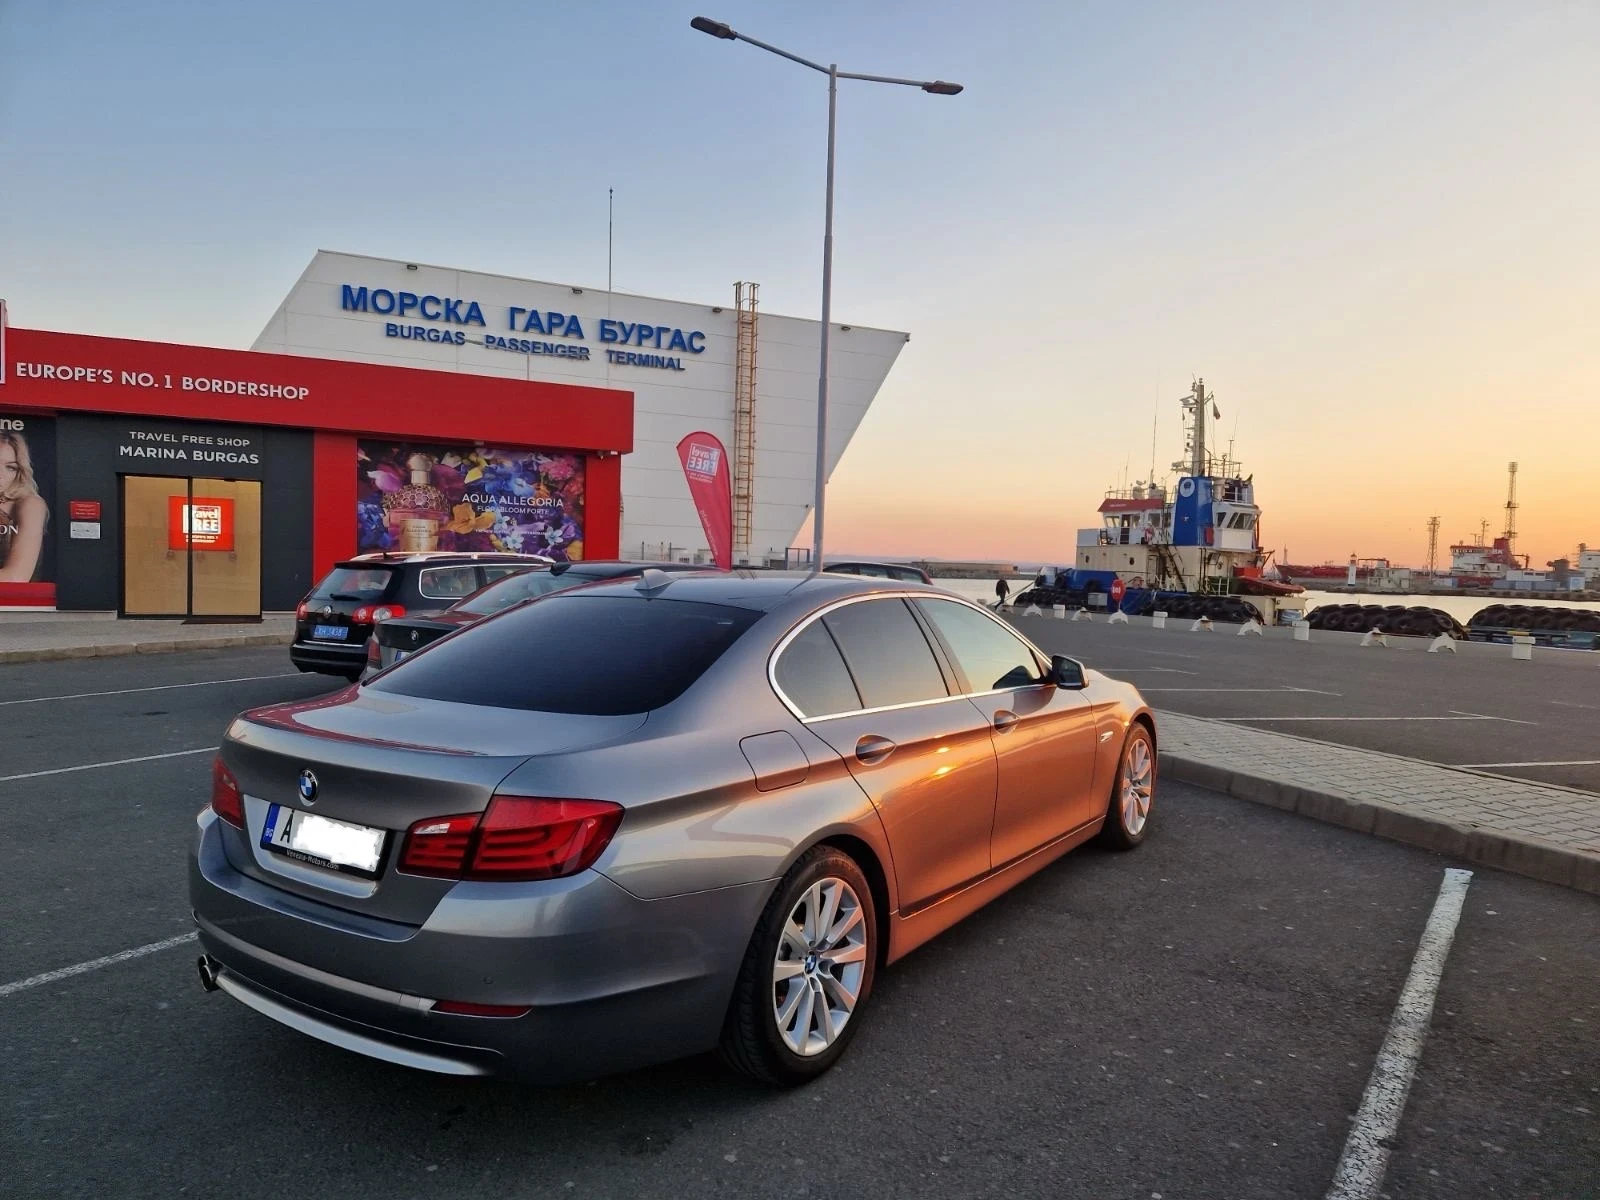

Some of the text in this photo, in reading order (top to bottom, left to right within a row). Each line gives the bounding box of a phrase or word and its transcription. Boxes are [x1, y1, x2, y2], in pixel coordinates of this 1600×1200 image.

[341, 284, 706, 354] МОРСКА ГАРА БУРГАС
[385, 322, 686, 371] BURGAS PASSENGER TERMINAL
[16, 361, 309, 400] EUROPE'S NO. 1 BORDERSHOP
[129, 431, 250, 447] TRAVEL FREE SHOP
[119, 445, 260, 464] MARINA BURGAS
[462, 493, 564, 508] AQUA ALLEGORIA
[500, 506, 526, 514] BLOOM
[526, 507, 550, 515] FORTE
[280, 810, 295, 843] A
